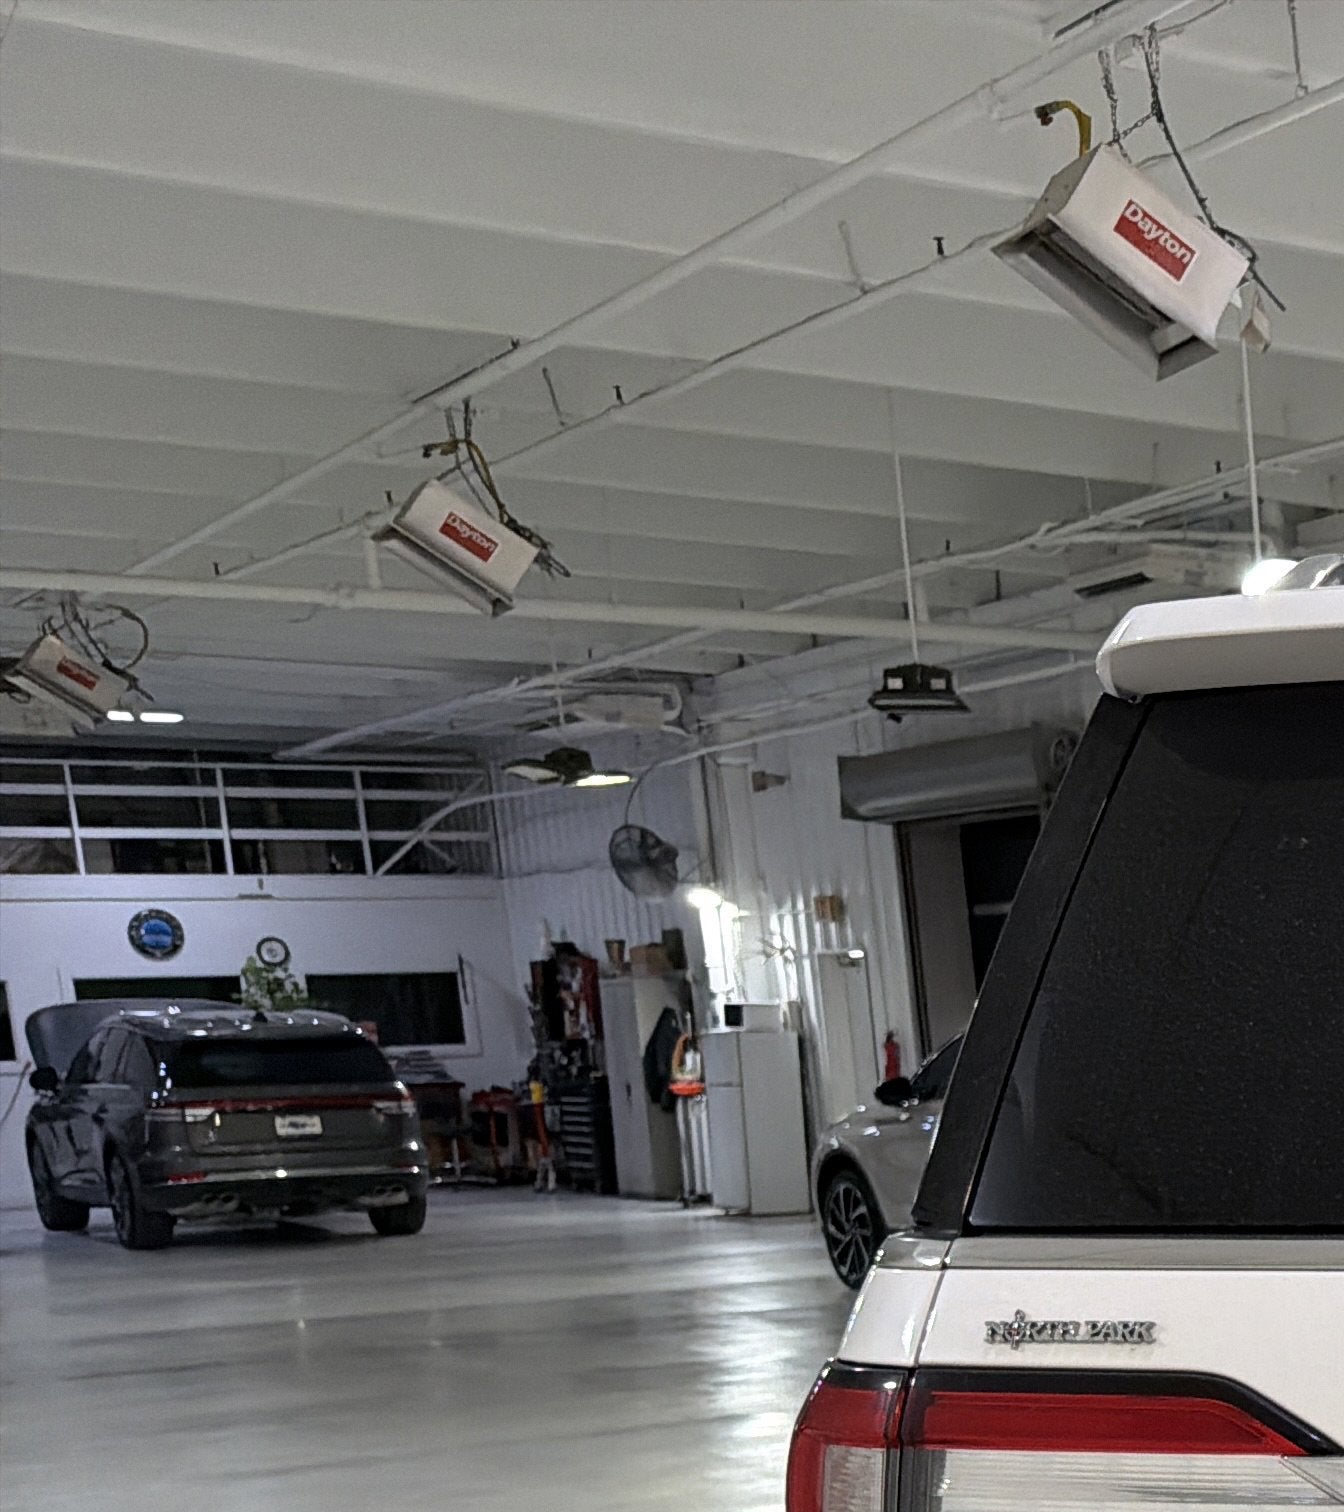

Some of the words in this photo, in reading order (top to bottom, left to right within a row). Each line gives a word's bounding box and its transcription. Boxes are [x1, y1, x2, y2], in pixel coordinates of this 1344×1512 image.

[1125, 204, 1193, 264] Dayton
[985, 1320, 1081, 1345] NORTH
[1085, 1321, 1156, 1344] PARK
